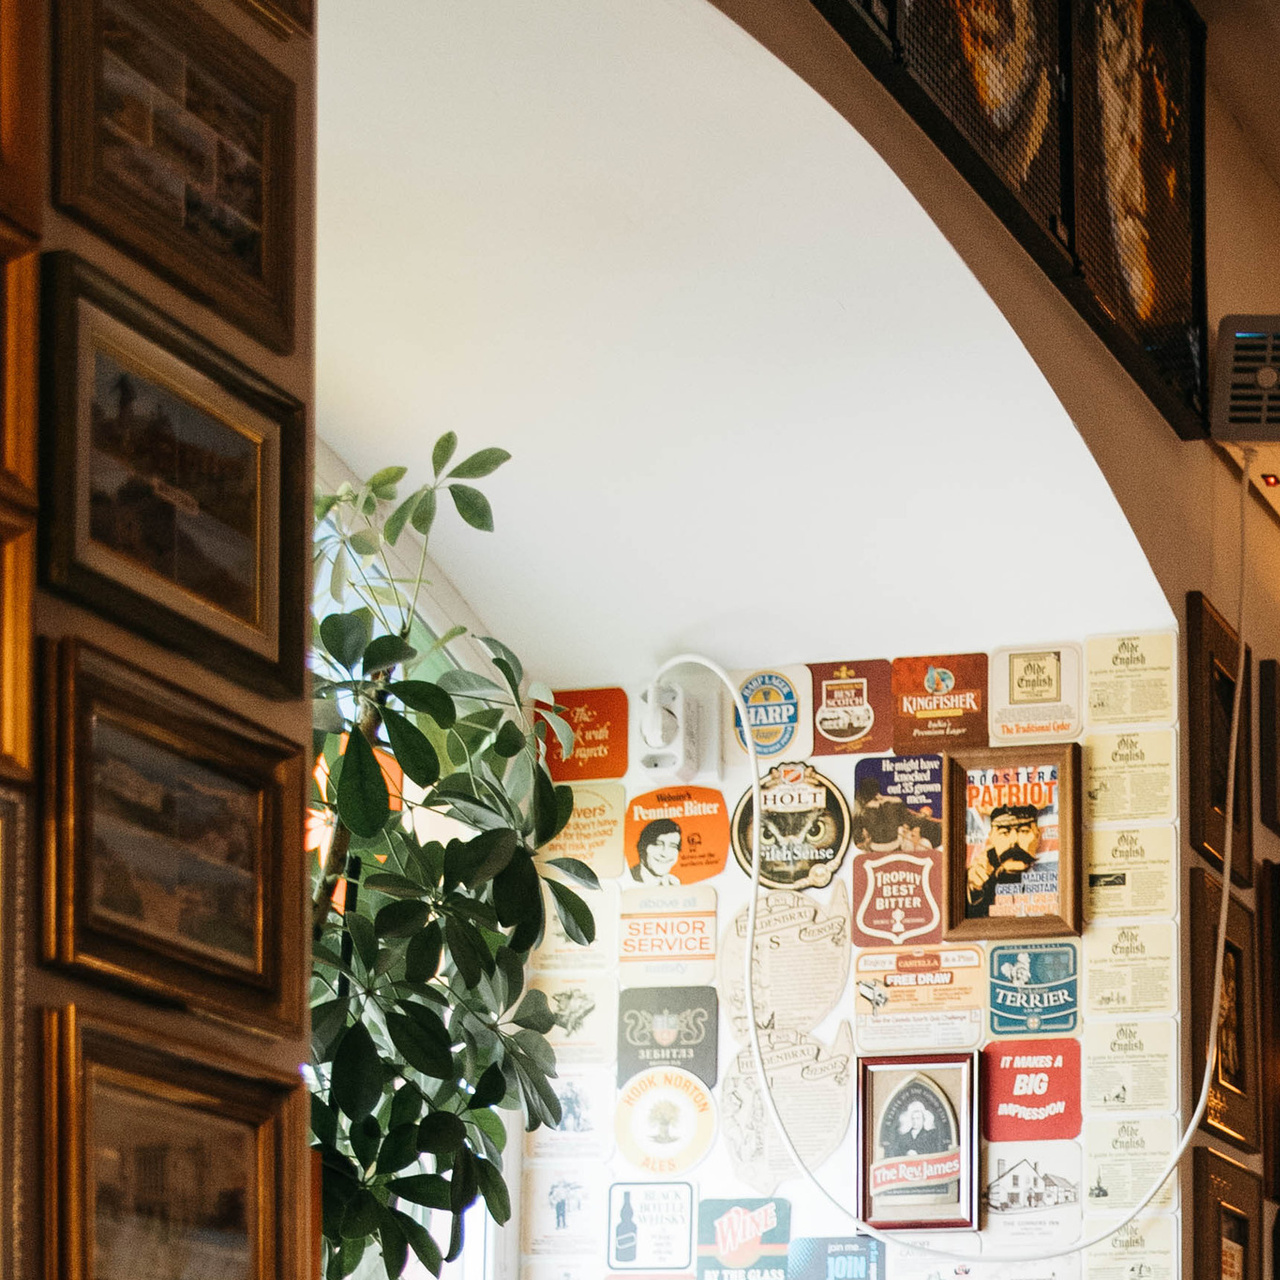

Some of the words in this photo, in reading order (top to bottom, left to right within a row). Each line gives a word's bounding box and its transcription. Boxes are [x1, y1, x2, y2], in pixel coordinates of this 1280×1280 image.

[1111, 654, 1146, 667] English
[1023, 662, 1046, 676] Olde
[1017, 675, 1054, 690] English
[902, 692, 978, 714] KINGFISHER
[746, 704, 795, 724] HARP
[1001, 724, 1015, 735] The
[1015, 723, 1051, 735] Traditional
[1111, 751, 1145, 764] English
[895, 759, 919, 772] might
[920, 758, 940, 770] have
[894, 770, 930, 783] knocked
[968, 771, 1058, 785] ROOSTERS
[915, 783, 941, 794] grown
[968, 781, 1057, 808] PATRIOT
[762, 793, 823, 806] HOLT
[633, 802, 682, 822] Pennine
[684, 800, 720, 816] Bitter
[792, 845, 835, 861] Sense
[1111, 847, 1145, 860] English
[875, 871, 922, 887] TROPHY
[882, 884, 916, 896] BEST
[1026, 883, 1058, 894] BRITAIN
[875, 897, 922, 910] BITTER
[628, 919, 706, 937] SENIOR
[622, 936, 711, 953] SERVICE
[1111, 943, 1145, 957] English
[886, 973, 917, 986] FREE
[917, 972, 951, 985] DRAW
[995, 988, 1075, 1008] TERRIER
[1109, 1039, 1144, 1054] English
[1001, 1056, 1012, 1068] IT
[1013, 1055, 1052, 1068] MAKES
[1053, 1055, 1063, 1068] A
[1013, 1073, 1049, 1096] BIG
[624, 1076, 656, 1107] HOOK
[663, 1073, 710, 1114] NORTON
[997, 1101, 1065, 1121] IMPRESSION
[1111, 1137, 1145, 1150] English
[641, 1157, 676, 1173] ALES
[874, 1168, 898, 1184] The
[899, 1164, 922, 1181] Rev.
[923, 1160, 960, 1178] James
[643, 1190, 682, 1200] BLACK
[640, 1201, 685, 1213] BOTTLE
[638, 1213, 687, 1226] WHISKY
[714, 1202, 778, 1256] WINE
[721, 1269, 746, 1280] THE
[748, 1269, 785, 1280] GLASS
